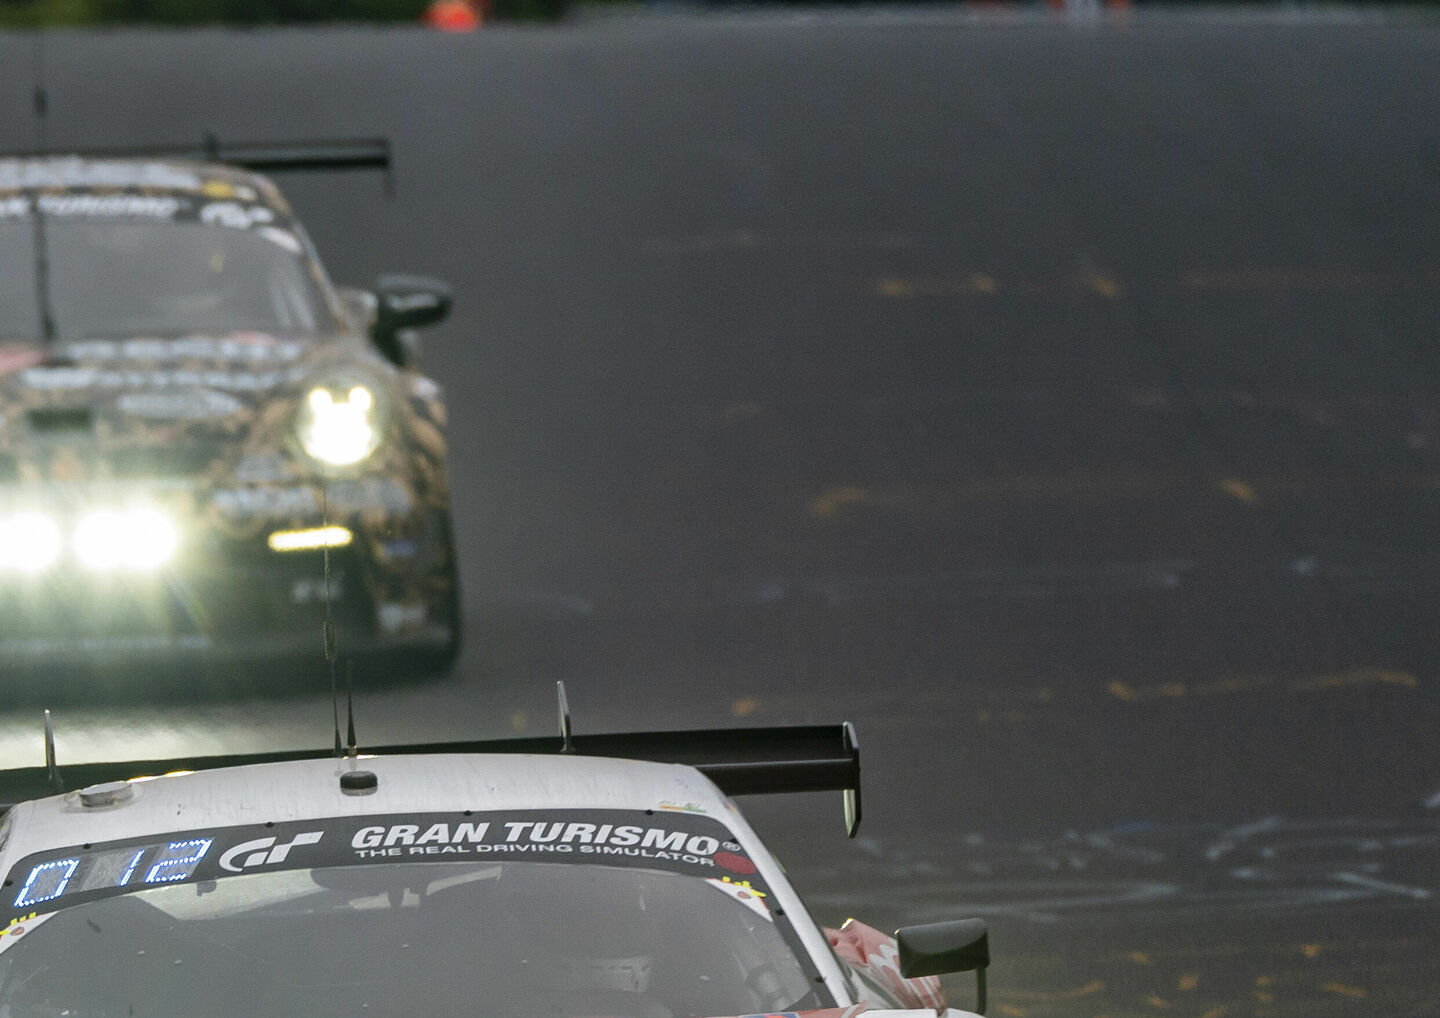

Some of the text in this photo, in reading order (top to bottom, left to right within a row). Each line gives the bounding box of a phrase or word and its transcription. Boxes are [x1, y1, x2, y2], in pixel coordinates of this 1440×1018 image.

[351, 823, 490, 848] GRAN
[503, 821, 720, 856] TURISMO
[355, 843, 716, 868] THE REAL DRIVING SIMULATOR
